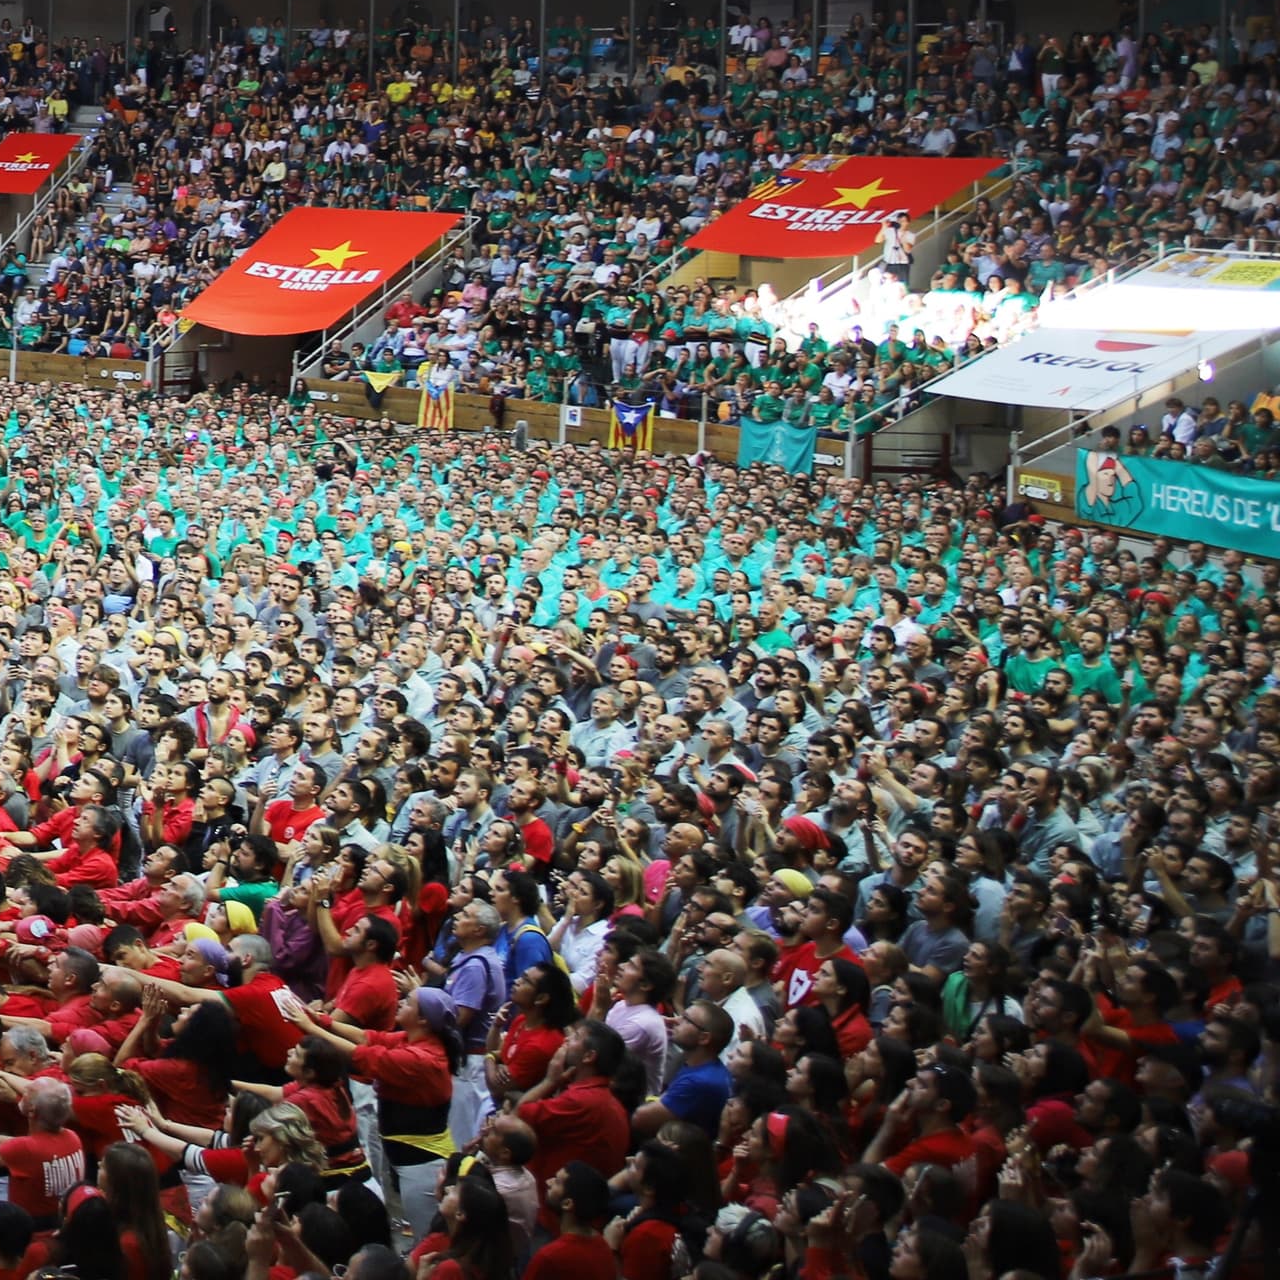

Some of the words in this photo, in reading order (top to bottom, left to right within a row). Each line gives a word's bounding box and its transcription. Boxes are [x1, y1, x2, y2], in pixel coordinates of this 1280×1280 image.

[748, 203, 910, 224] ESTRELLA
[786, 222, 845, 232] DAMM
[244, 261, 382, 285] ESTRELLA
[278, 281, 329, 292] DAMM
[1019, 352, 1154, 374] REPSOL
[1151, 482, 1231, 522] HEREUS
[1233, 497, 1261, 528] DE
